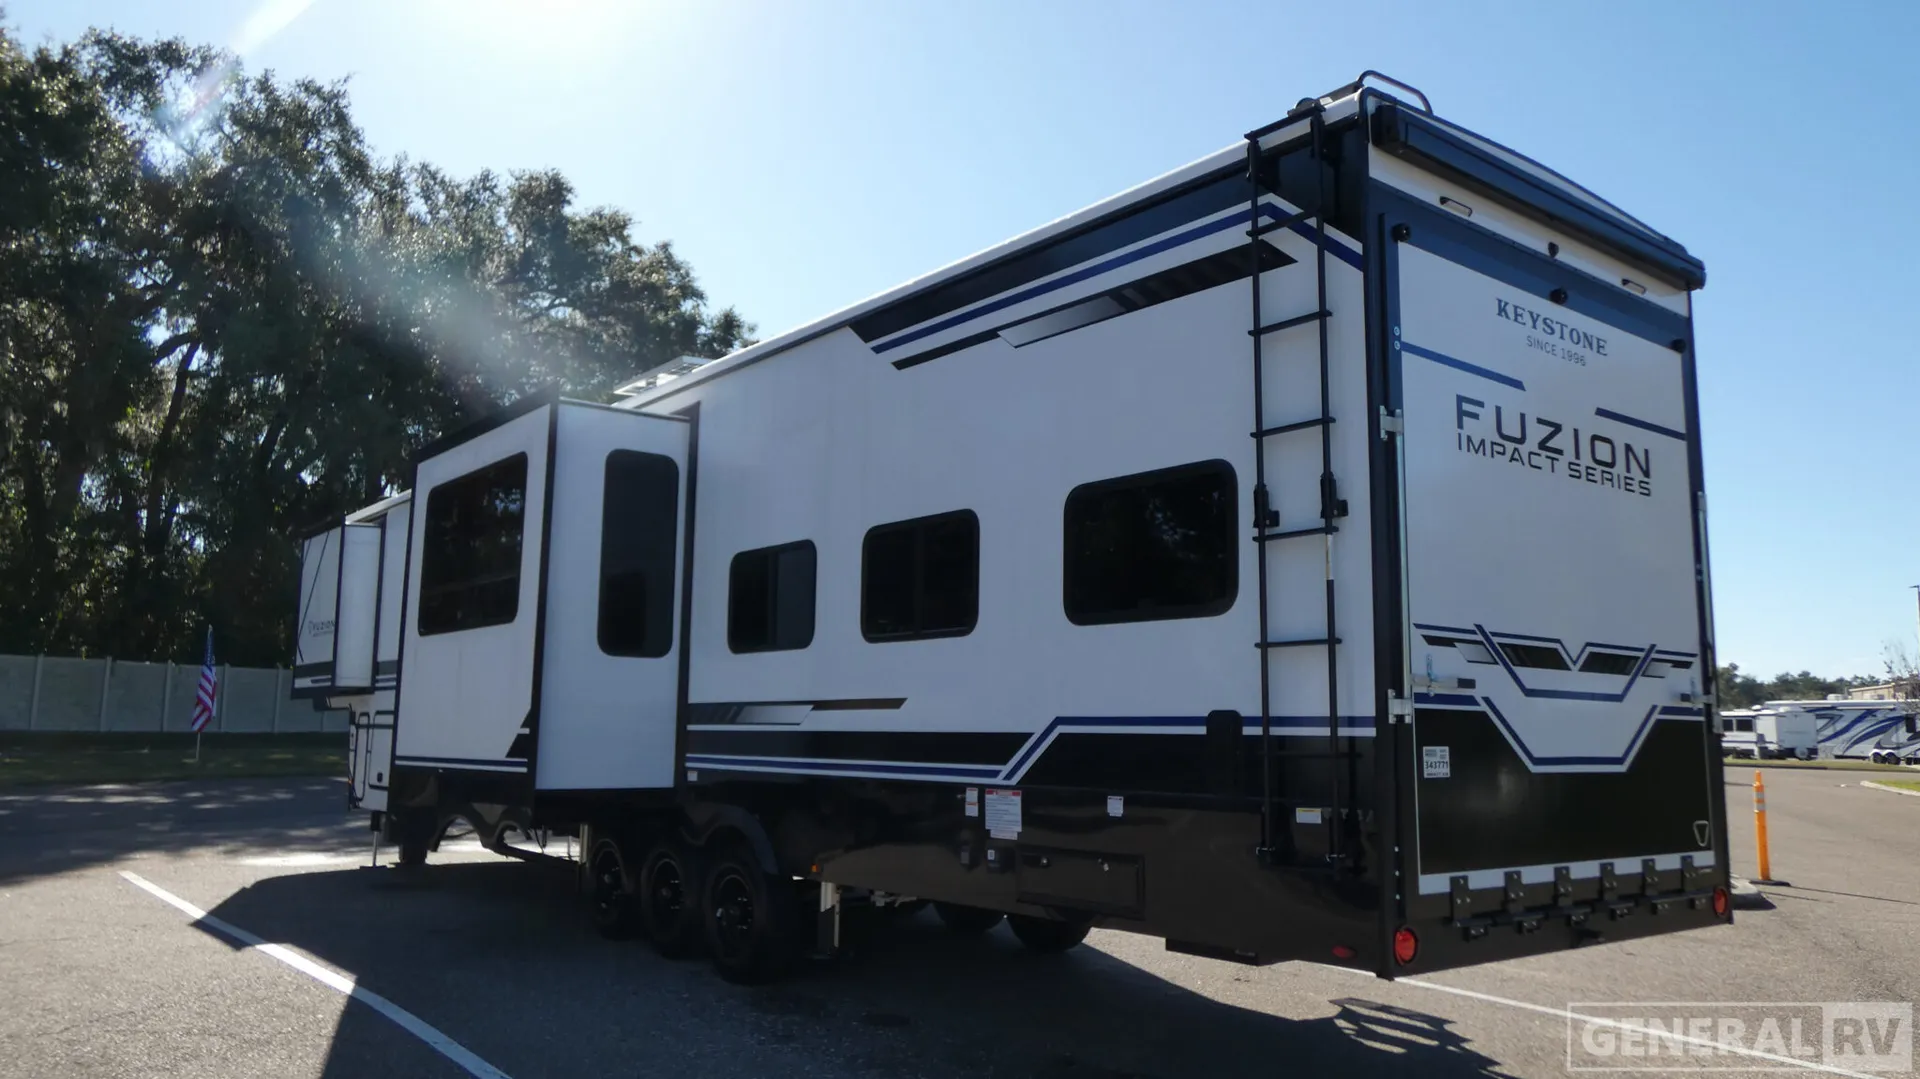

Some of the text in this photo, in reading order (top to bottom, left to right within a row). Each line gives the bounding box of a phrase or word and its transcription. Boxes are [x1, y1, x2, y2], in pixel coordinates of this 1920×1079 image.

[1496, 297, 1608, 357] KEYSTONE
[1526, 335, 1587, 367] SINCE 1996
[1456, 394, 1651, 479] FUZION
[1457, 432, 1652, 498] IMPACT SERIES
